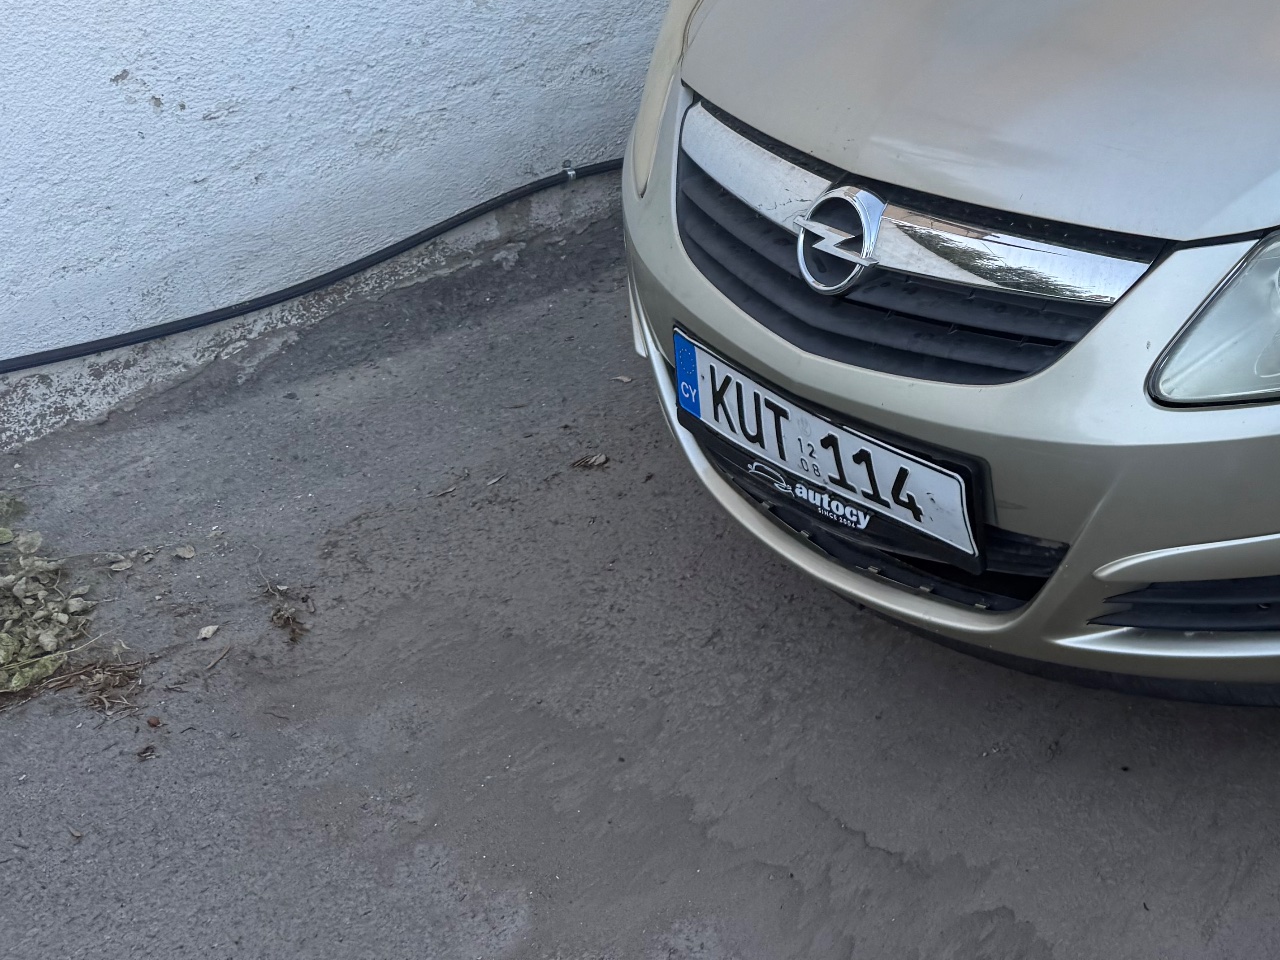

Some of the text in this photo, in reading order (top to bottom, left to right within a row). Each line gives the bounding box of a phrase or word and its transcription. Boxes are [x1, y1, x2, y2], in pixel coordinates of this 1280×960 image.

[681, 381, 697, 403] CY
[709, 363, 924, 523] KUT 114
[797, 437, 817, 459] 12
[800, 457, 821, 477] 08
[795, 483, 871, 529] autocy
[817, 507, 838, 520] SINCE
